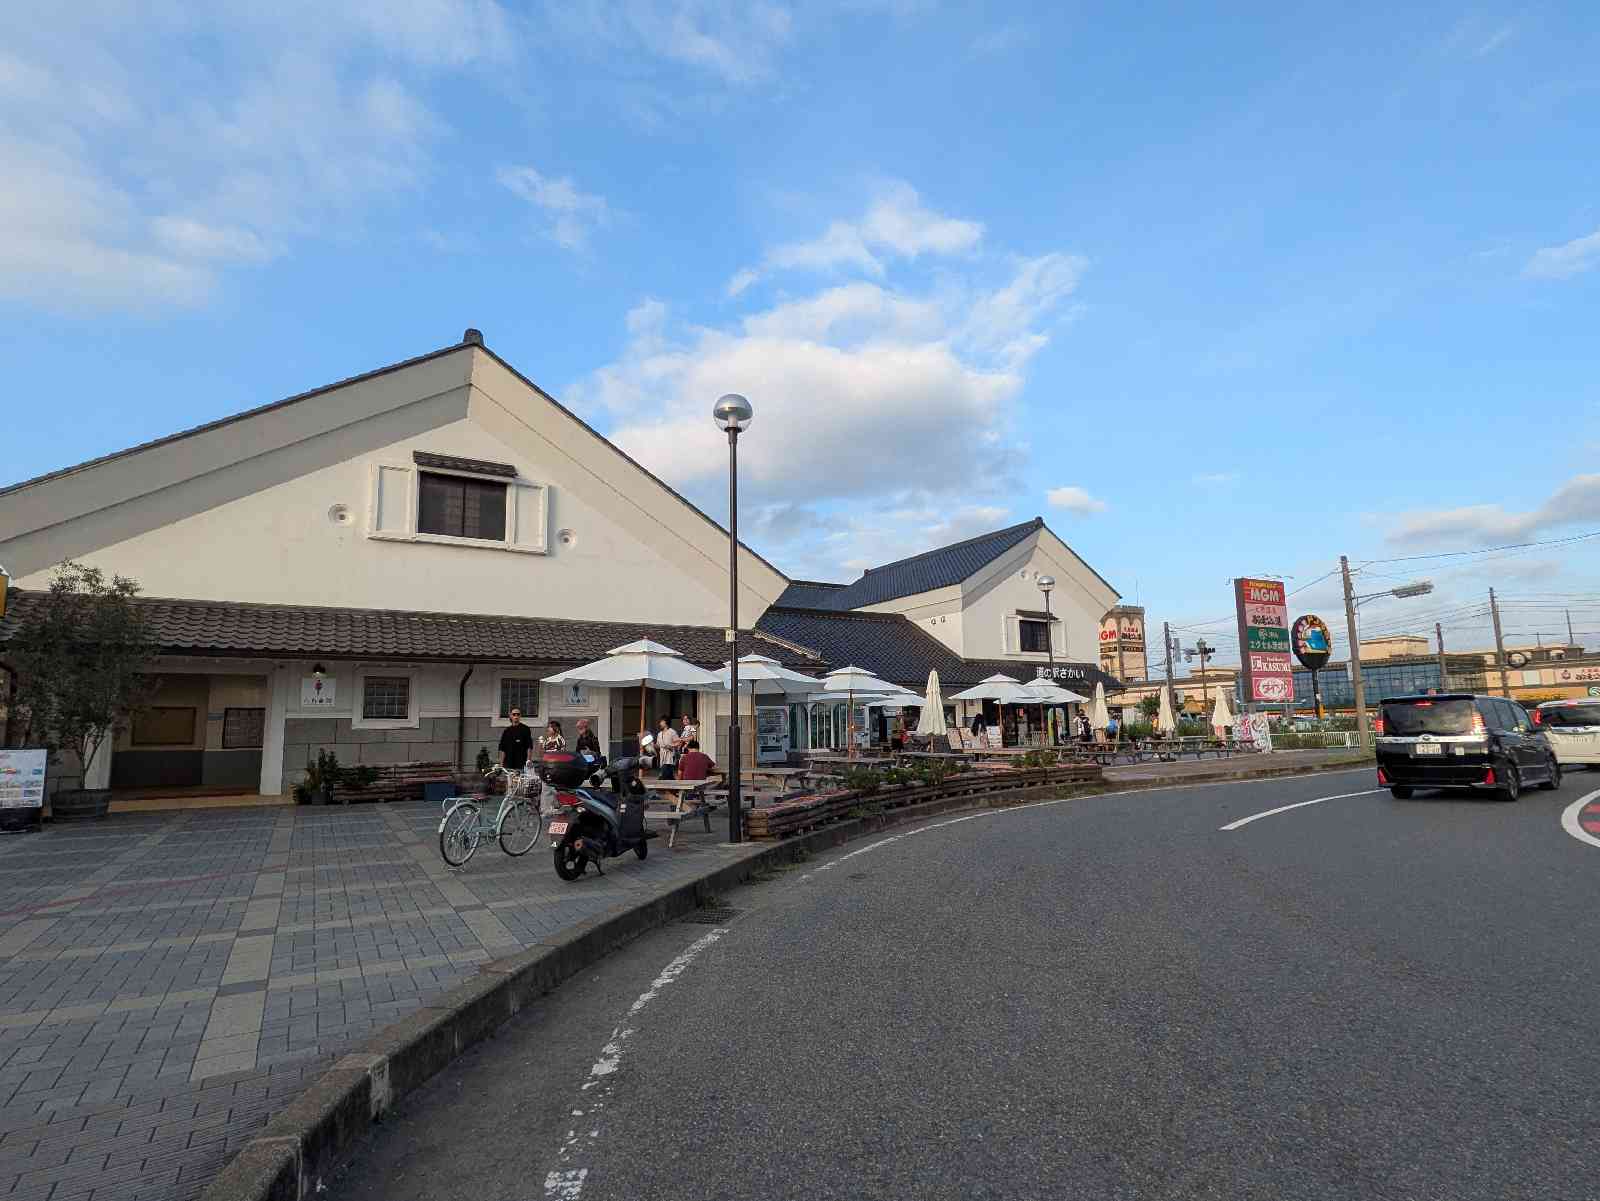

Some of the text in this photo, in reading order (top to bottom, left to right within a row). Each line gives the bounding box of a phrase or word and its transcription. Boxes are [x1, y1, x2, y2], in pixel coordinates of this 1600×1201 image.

[1250, 588, 1280, 602] MGM
[1099, 630, 1117, 640] GM
[1263, 662, 1291, 672] KASUMI
